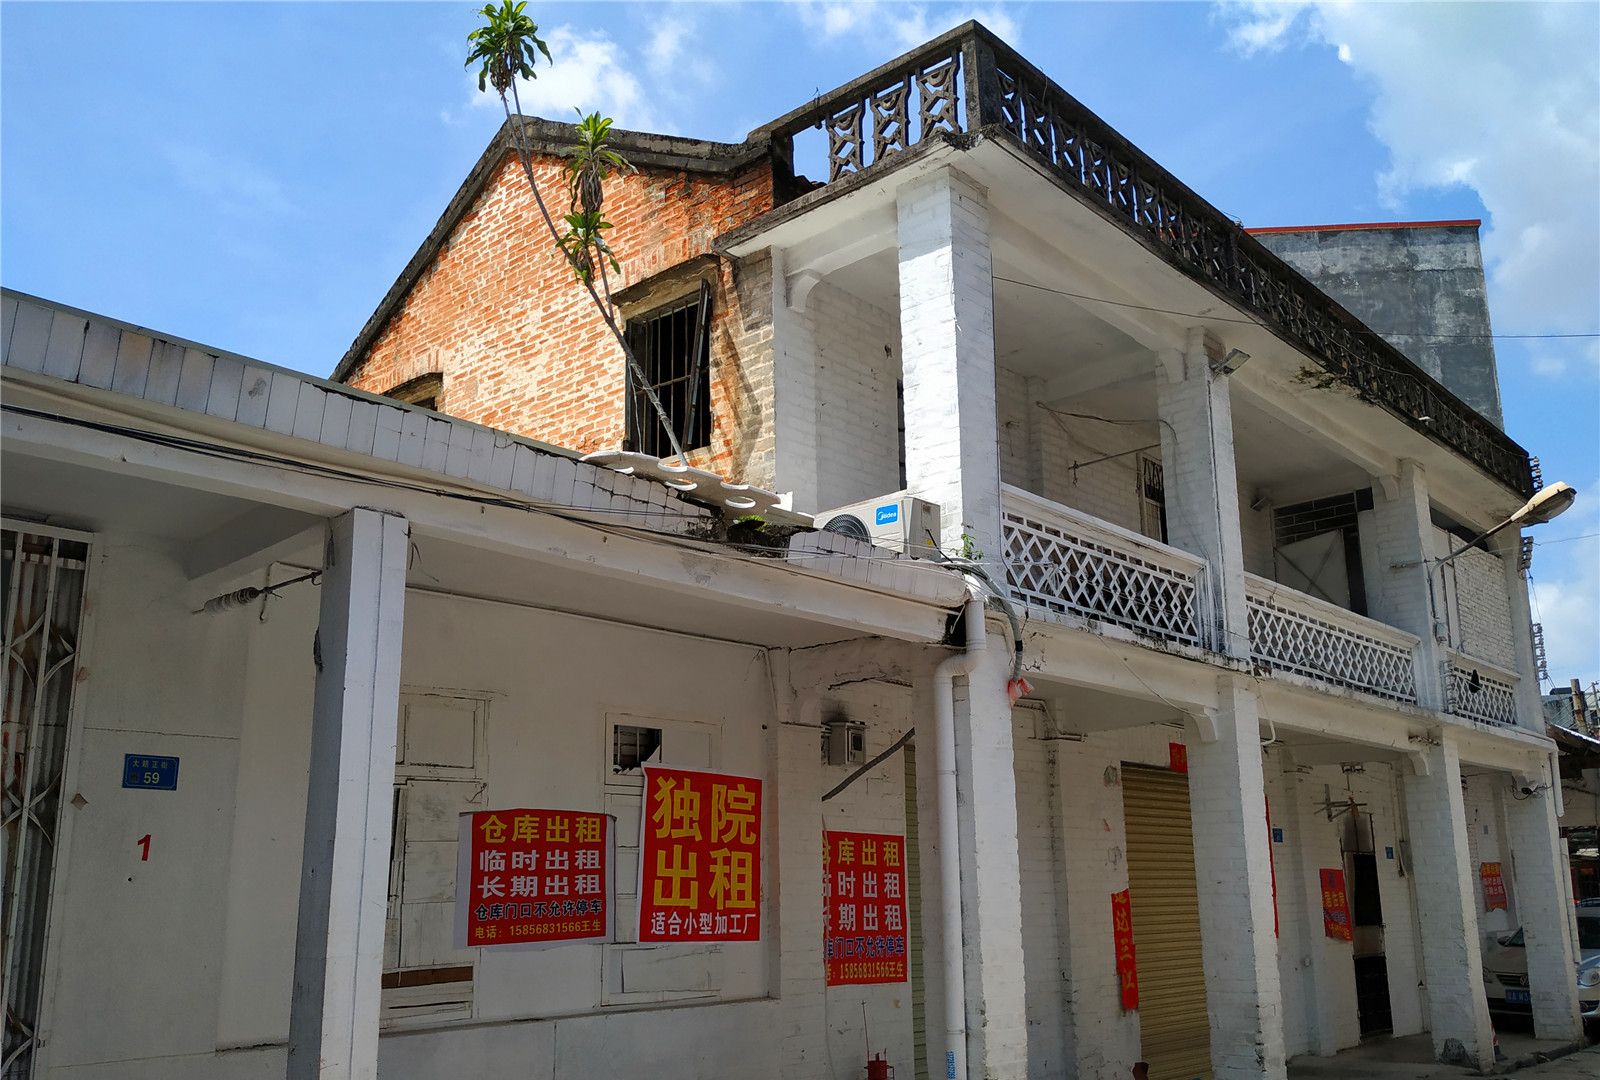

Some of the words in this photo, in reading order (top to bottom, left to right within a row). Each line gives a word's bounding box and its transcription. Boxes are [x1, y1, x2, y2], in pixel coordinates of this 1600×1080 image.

[877, 511, 897, 521] Midea
[143, 771, 160, 784] 59
[652, 776, 756, 845] 独院
[480, 814, 602, 843] 仓库出租
[137, 833, 151, 861] 1
[479, 849, 601, 872] 临时出租
[477, 874, 601, 899] 长期出租
[653, 844, 756, 910] 出租
[475, 899, 602, 921] 仓库门口不允许停车
[650, 911, 756, 936] 适合小型加工厂
